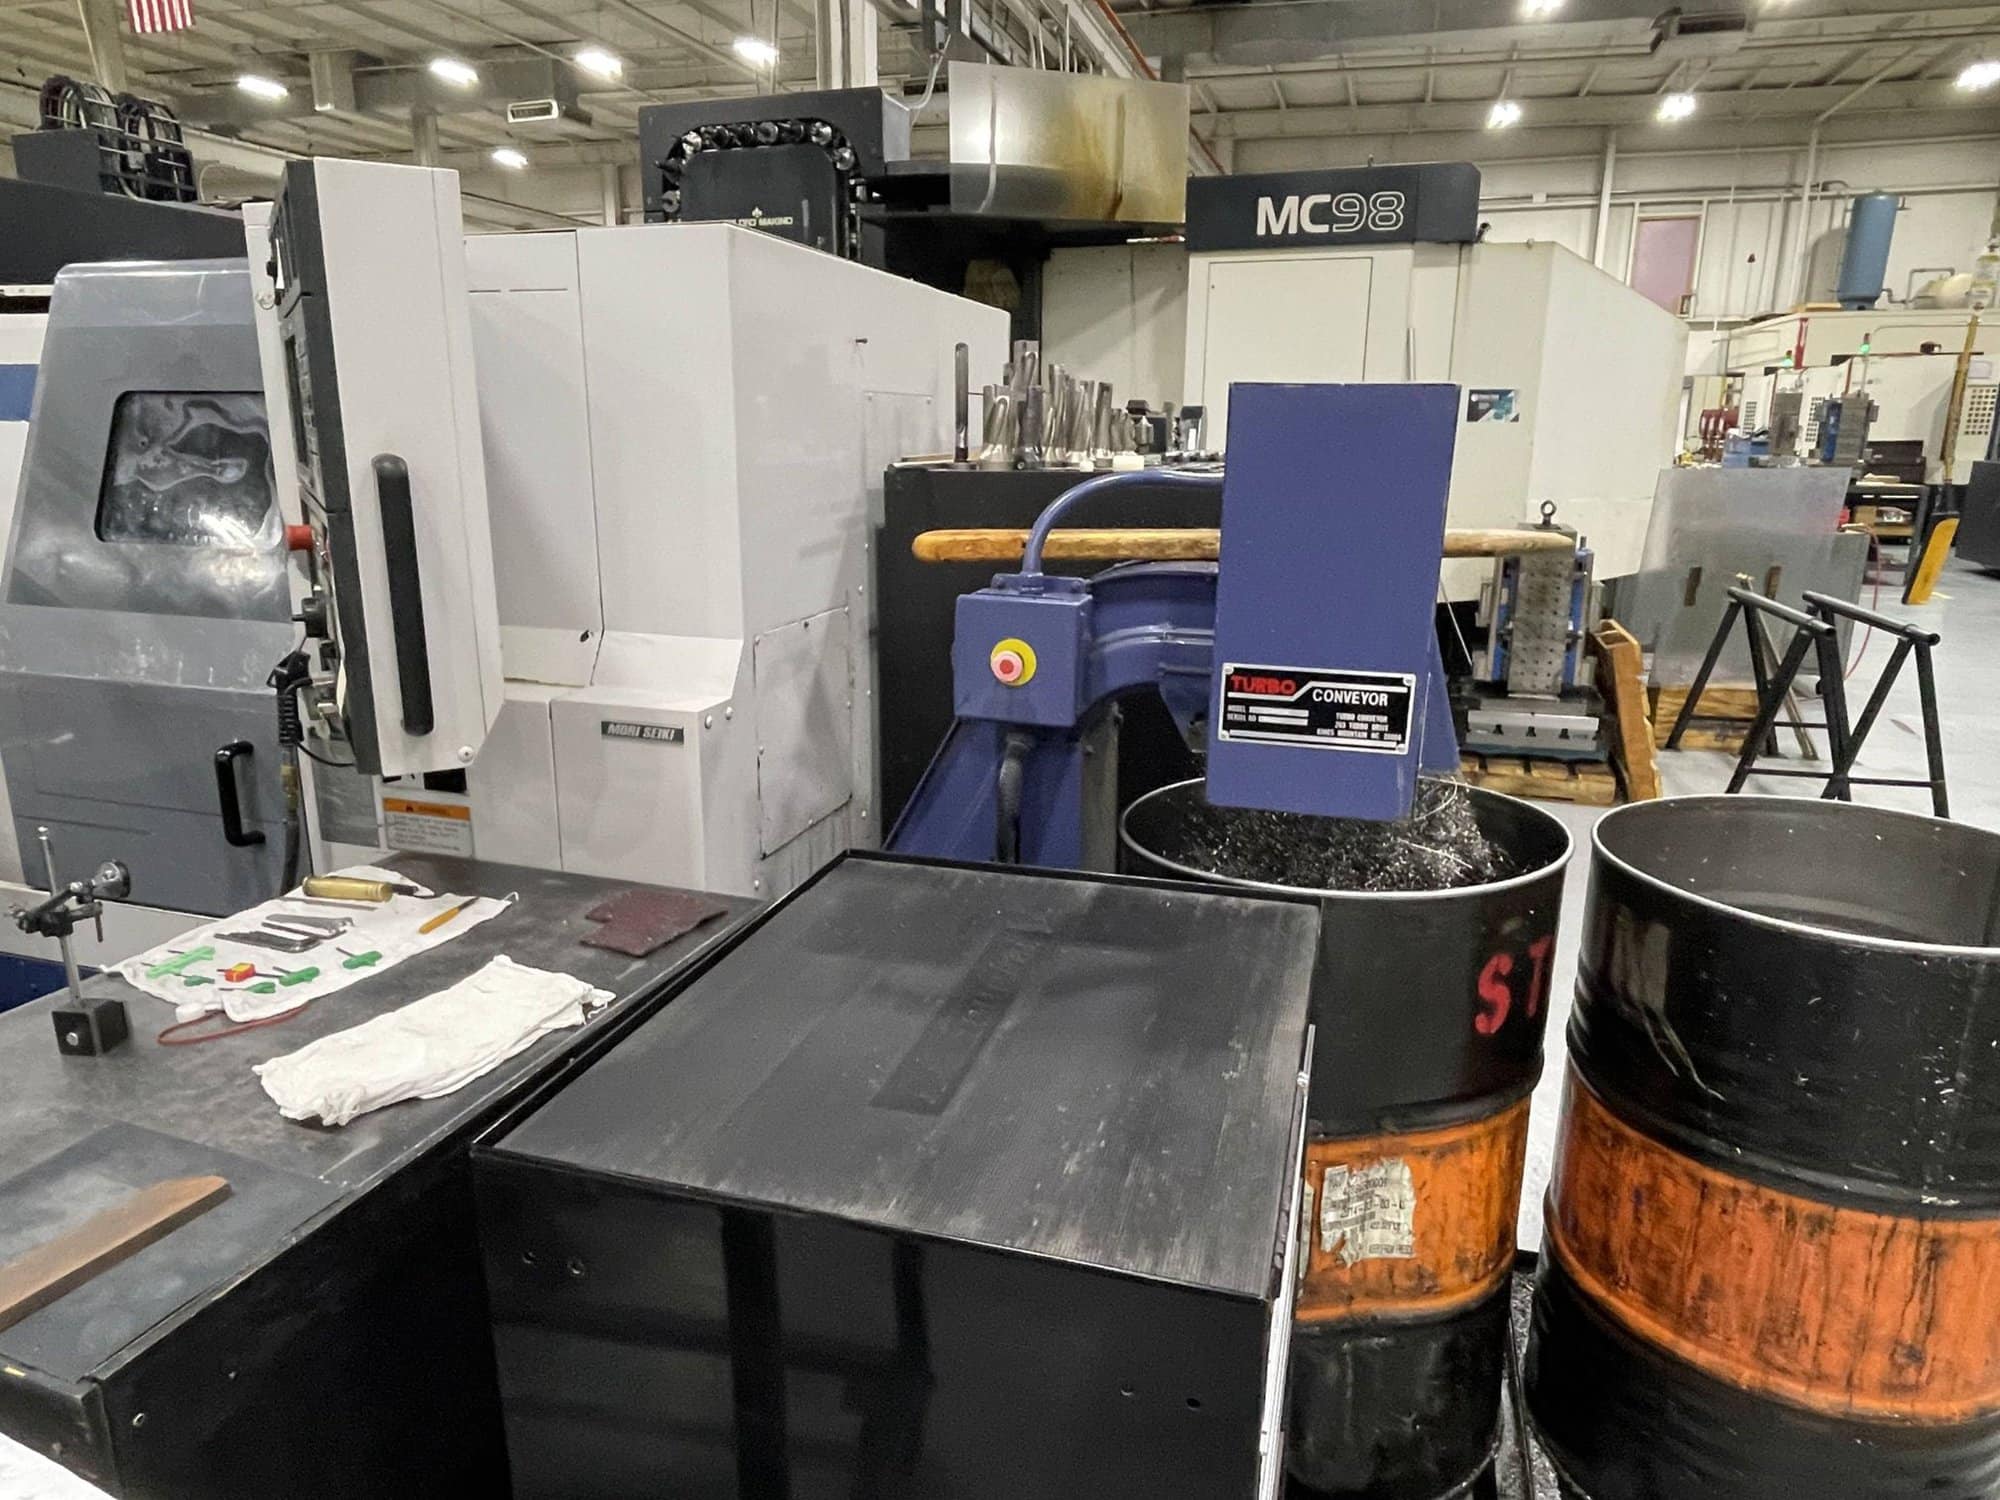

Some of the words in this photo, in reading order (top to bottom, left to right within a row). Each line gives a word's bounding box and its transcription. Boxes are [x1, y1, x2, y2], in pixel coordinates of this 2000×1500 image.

[1256, 191, 1405, 236] MC98
[1230, 674, 1296, 695] TURBO
[1312, 689, 1388, 706] CONVEYOR
[607, 723, 640, 737] MORI
[642, 727, 675, 740] SEIKI
